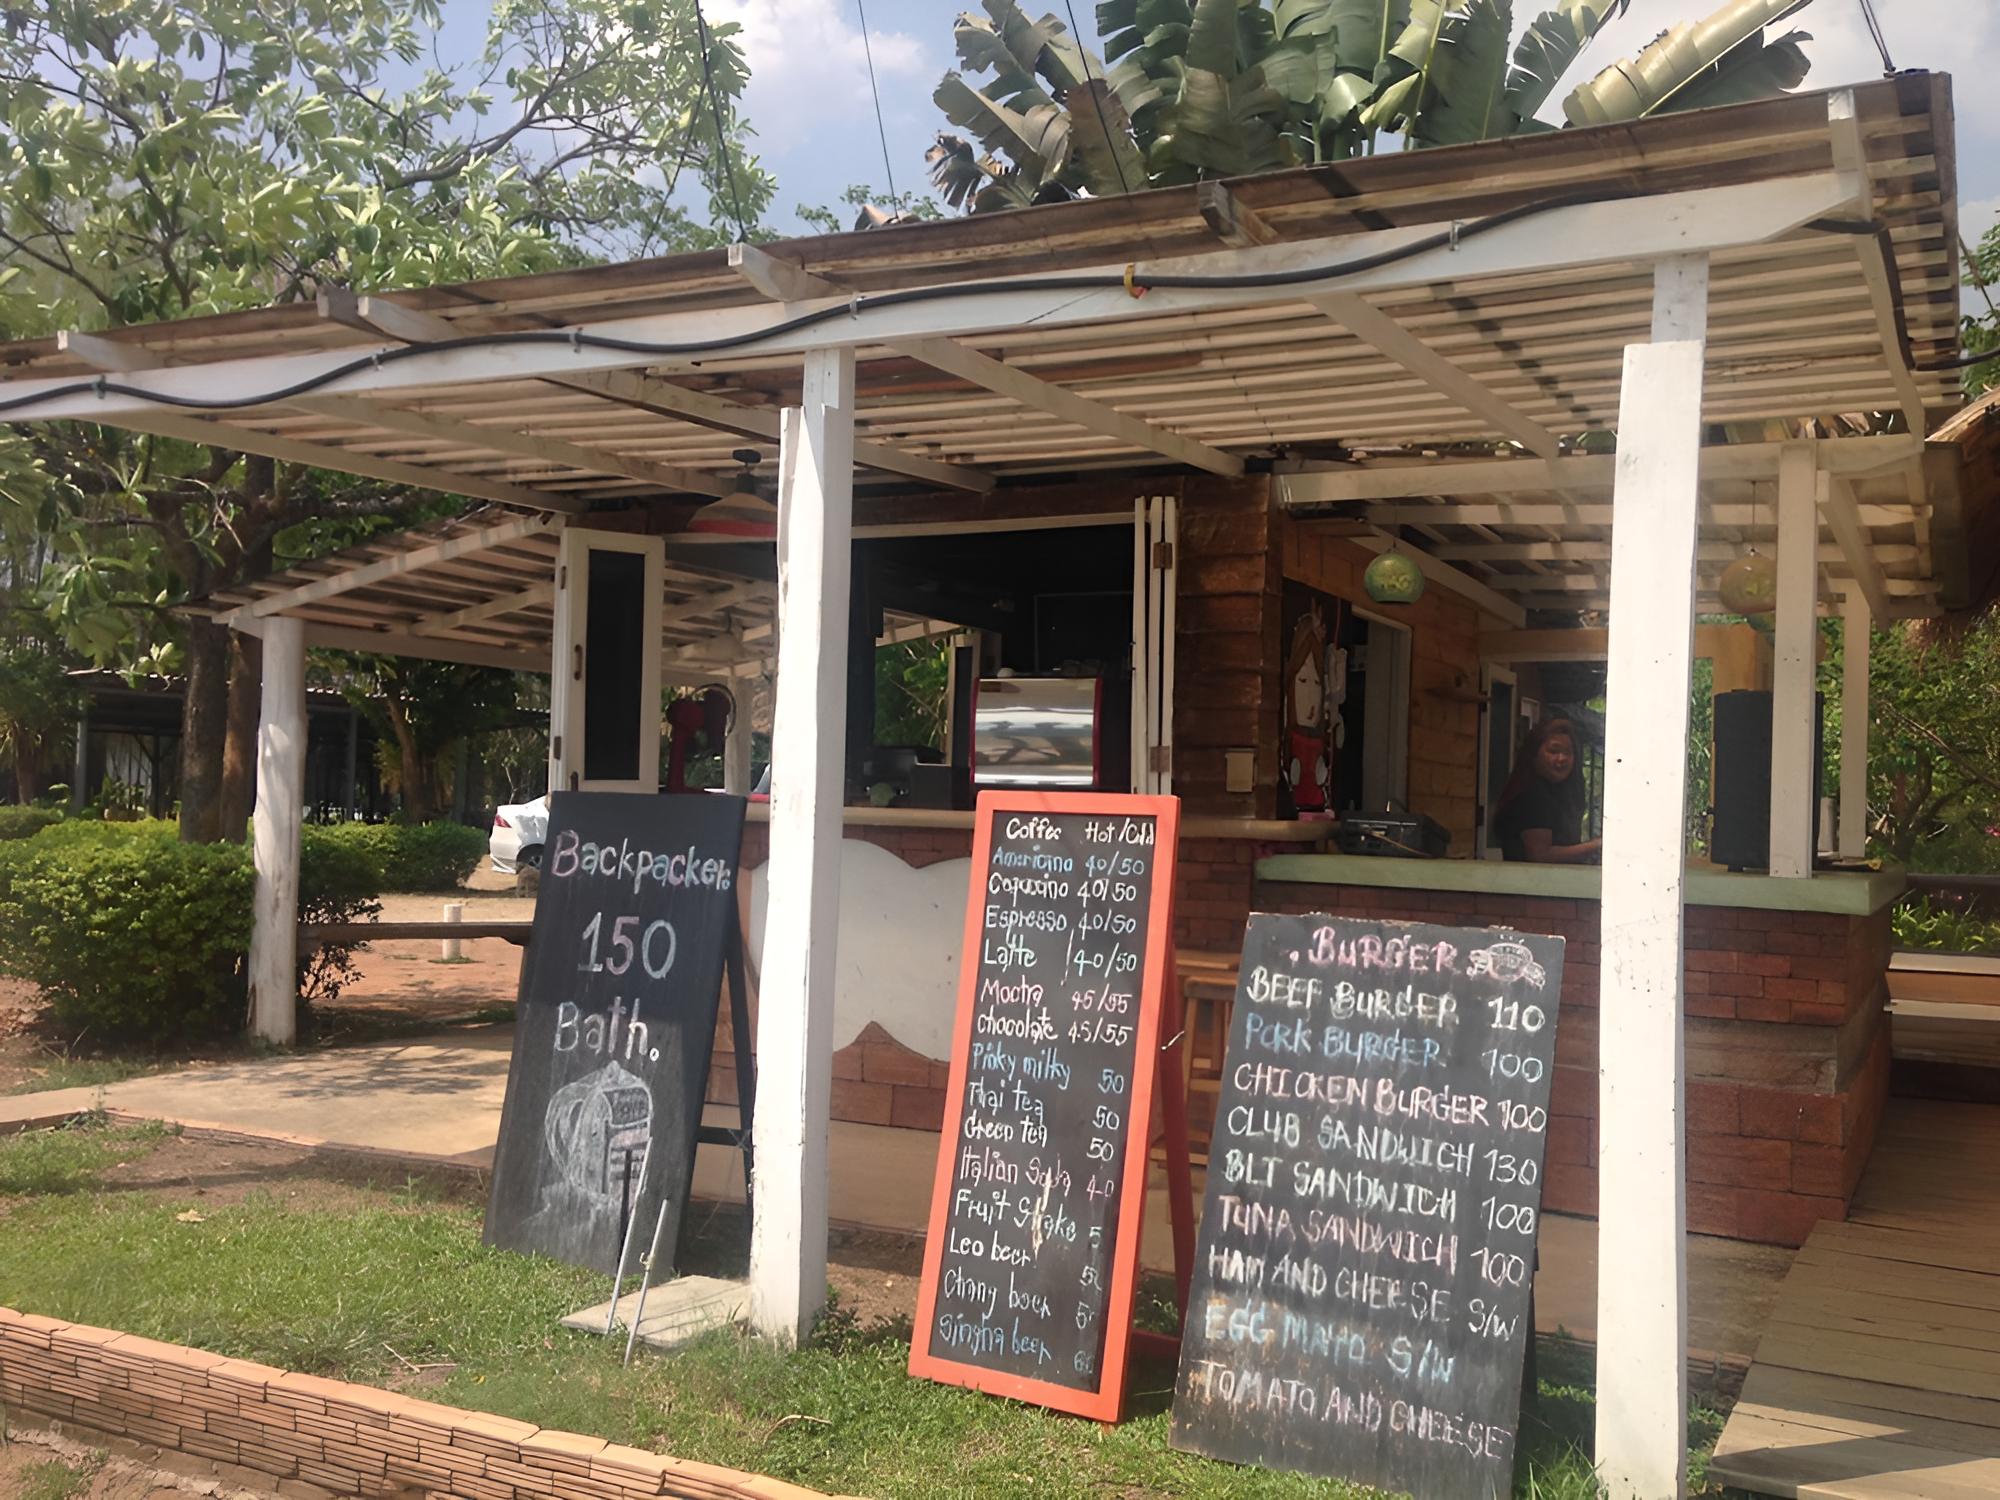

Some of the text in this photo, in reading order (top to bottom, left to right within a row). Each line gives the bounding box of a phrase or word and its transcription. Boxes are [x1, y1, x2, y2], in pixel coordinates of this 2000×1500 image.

[1006, 817, 1062, 840] Coffee
[577, 911, 676, 980] 150
[985, 905, 1137, 947] Espresso 40/50
[984, 934, 1037, 972] Latte
[980, 975, 1044, 1007] Mocha
[1247, 966, 1322, 1008] BEEF
[1488, 996, 1545, 1032] 110
[973, 1041, 1124, 1094] Pinky milky 50
[1481, 1049, 1544, 1082] 100
[969, 1076, 1120, 1130] Thai tea 50
[1234, 1063, 1367, 1106] CHICKEN
[1498, 1099, 1547, 1132] 100
[965, 1109, 1014, 1142] Green
[1087, 1138, 1114, 1161] 50
[1317, 1115, 1475, 1176] SANDWICH
[1483, 1149, 1538, 1185] 130
[960, 1145, 1019, 1187] Italian
[955, 1189, 1011, 1225] Fruit
[1225, 1148, 1535, 1235] BLT SANDWICH 100
[949, 1227, 984, 1257] Leo
[991, 1230, 1031, 1266] beer
[1301, 1209, 1458, 1276] SANDWICH
[1470, 1247, 1526, 1287] 100
[944, 1266, 998, 1319] Chang
[1009, 1271, 1052, 1319] beer
[1271, 1253, 1328, 1297] AND
[1012, 1317, 1052, 1365] beer
[1205, 1298, 1275, 1344] EGG
[1191, 1359, 1316, 1416] TOMATO
[1321, 1386, 1382, 1432] AND
